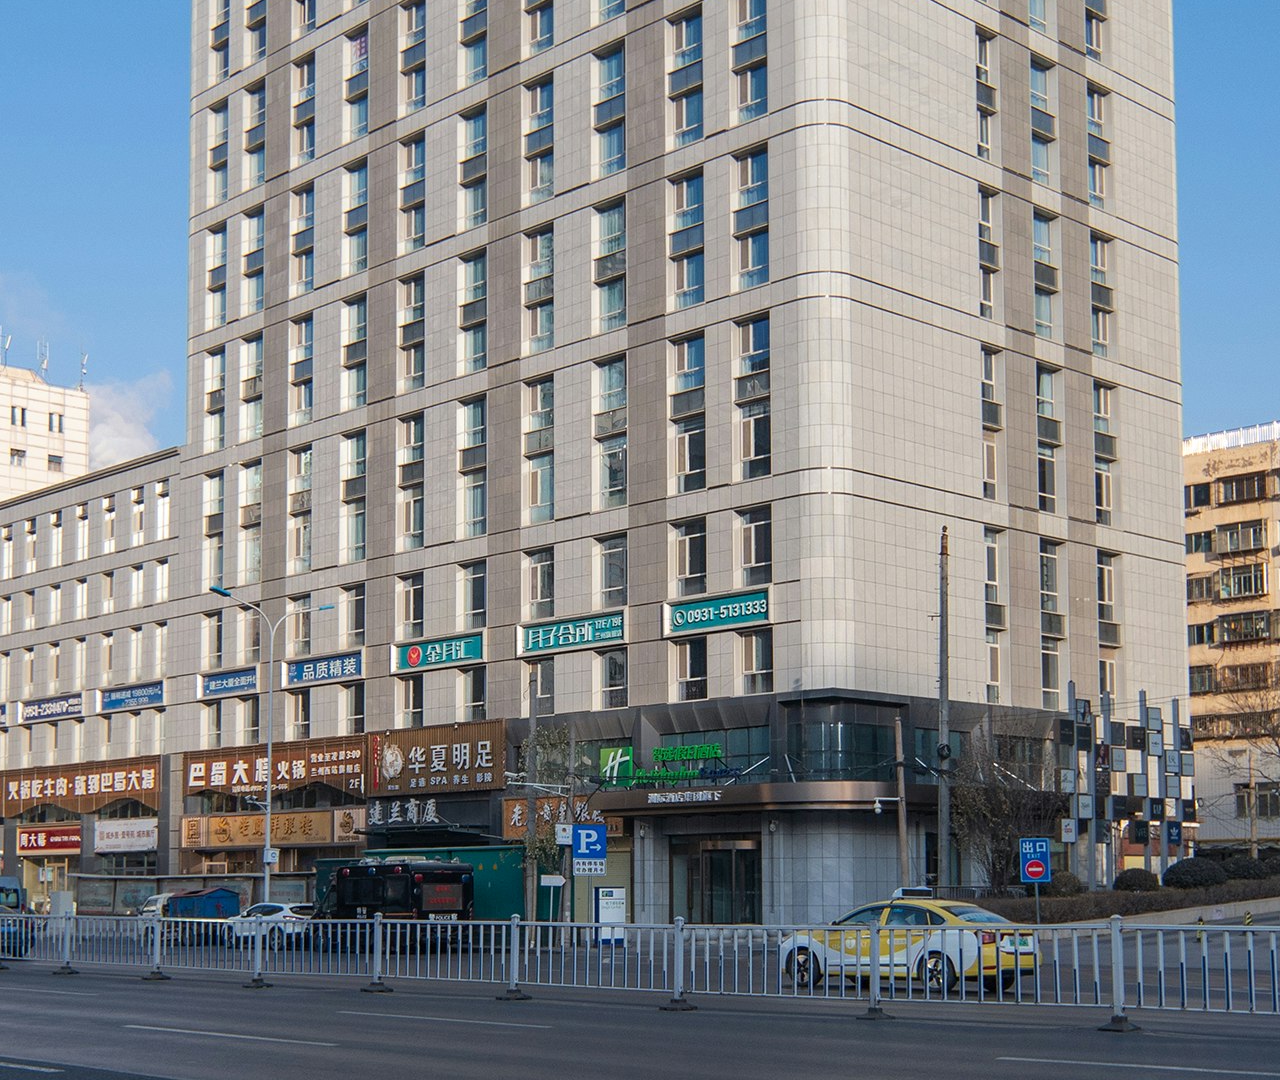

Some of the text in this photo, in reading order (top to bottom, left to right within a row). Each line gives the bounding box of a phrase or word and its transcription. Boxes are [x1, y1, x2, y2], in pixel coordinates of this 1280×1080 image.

[687, 599, 768, 624] 0931-5131333
[302, 657, 357, 680] 品质精装
[408, 740, 493, 774] 华夏明足
[349, 779, 360, 789] 2F
[430, 776, 448, 785] SPA
[368, 798, 440, 825] 建兰商厦
[578, 829, 598, 853] P
[1022, 842, 1047, 853] 出口
